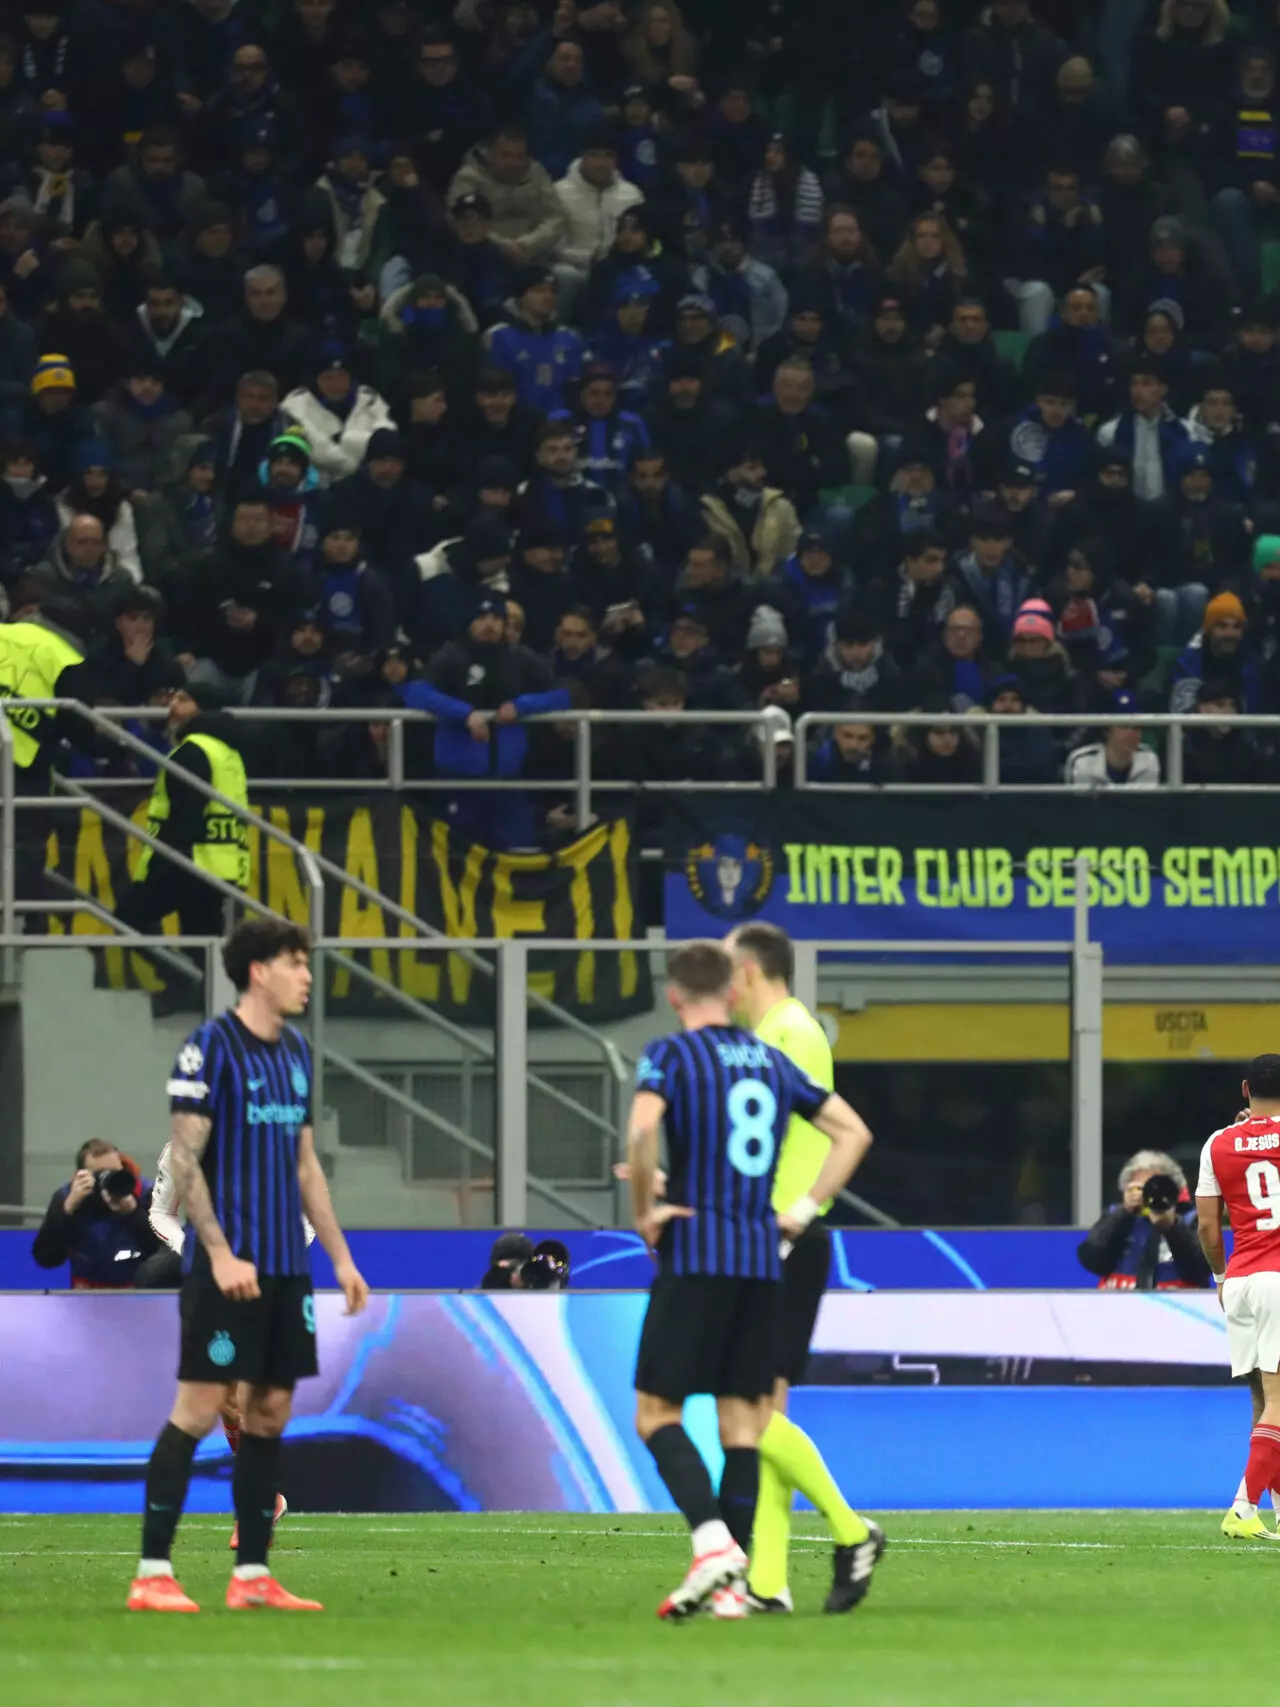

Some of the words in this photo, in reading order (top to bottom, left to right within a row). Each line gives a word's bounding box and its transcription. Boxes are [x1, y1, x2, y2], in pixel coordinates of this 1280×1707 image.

[784, 843, 905, 905] INTER
[913, 847, 1014, 907] CLUB
[1026, 846, 1151, 907] SESSO
[726, 1077, 777, 1178] 8
